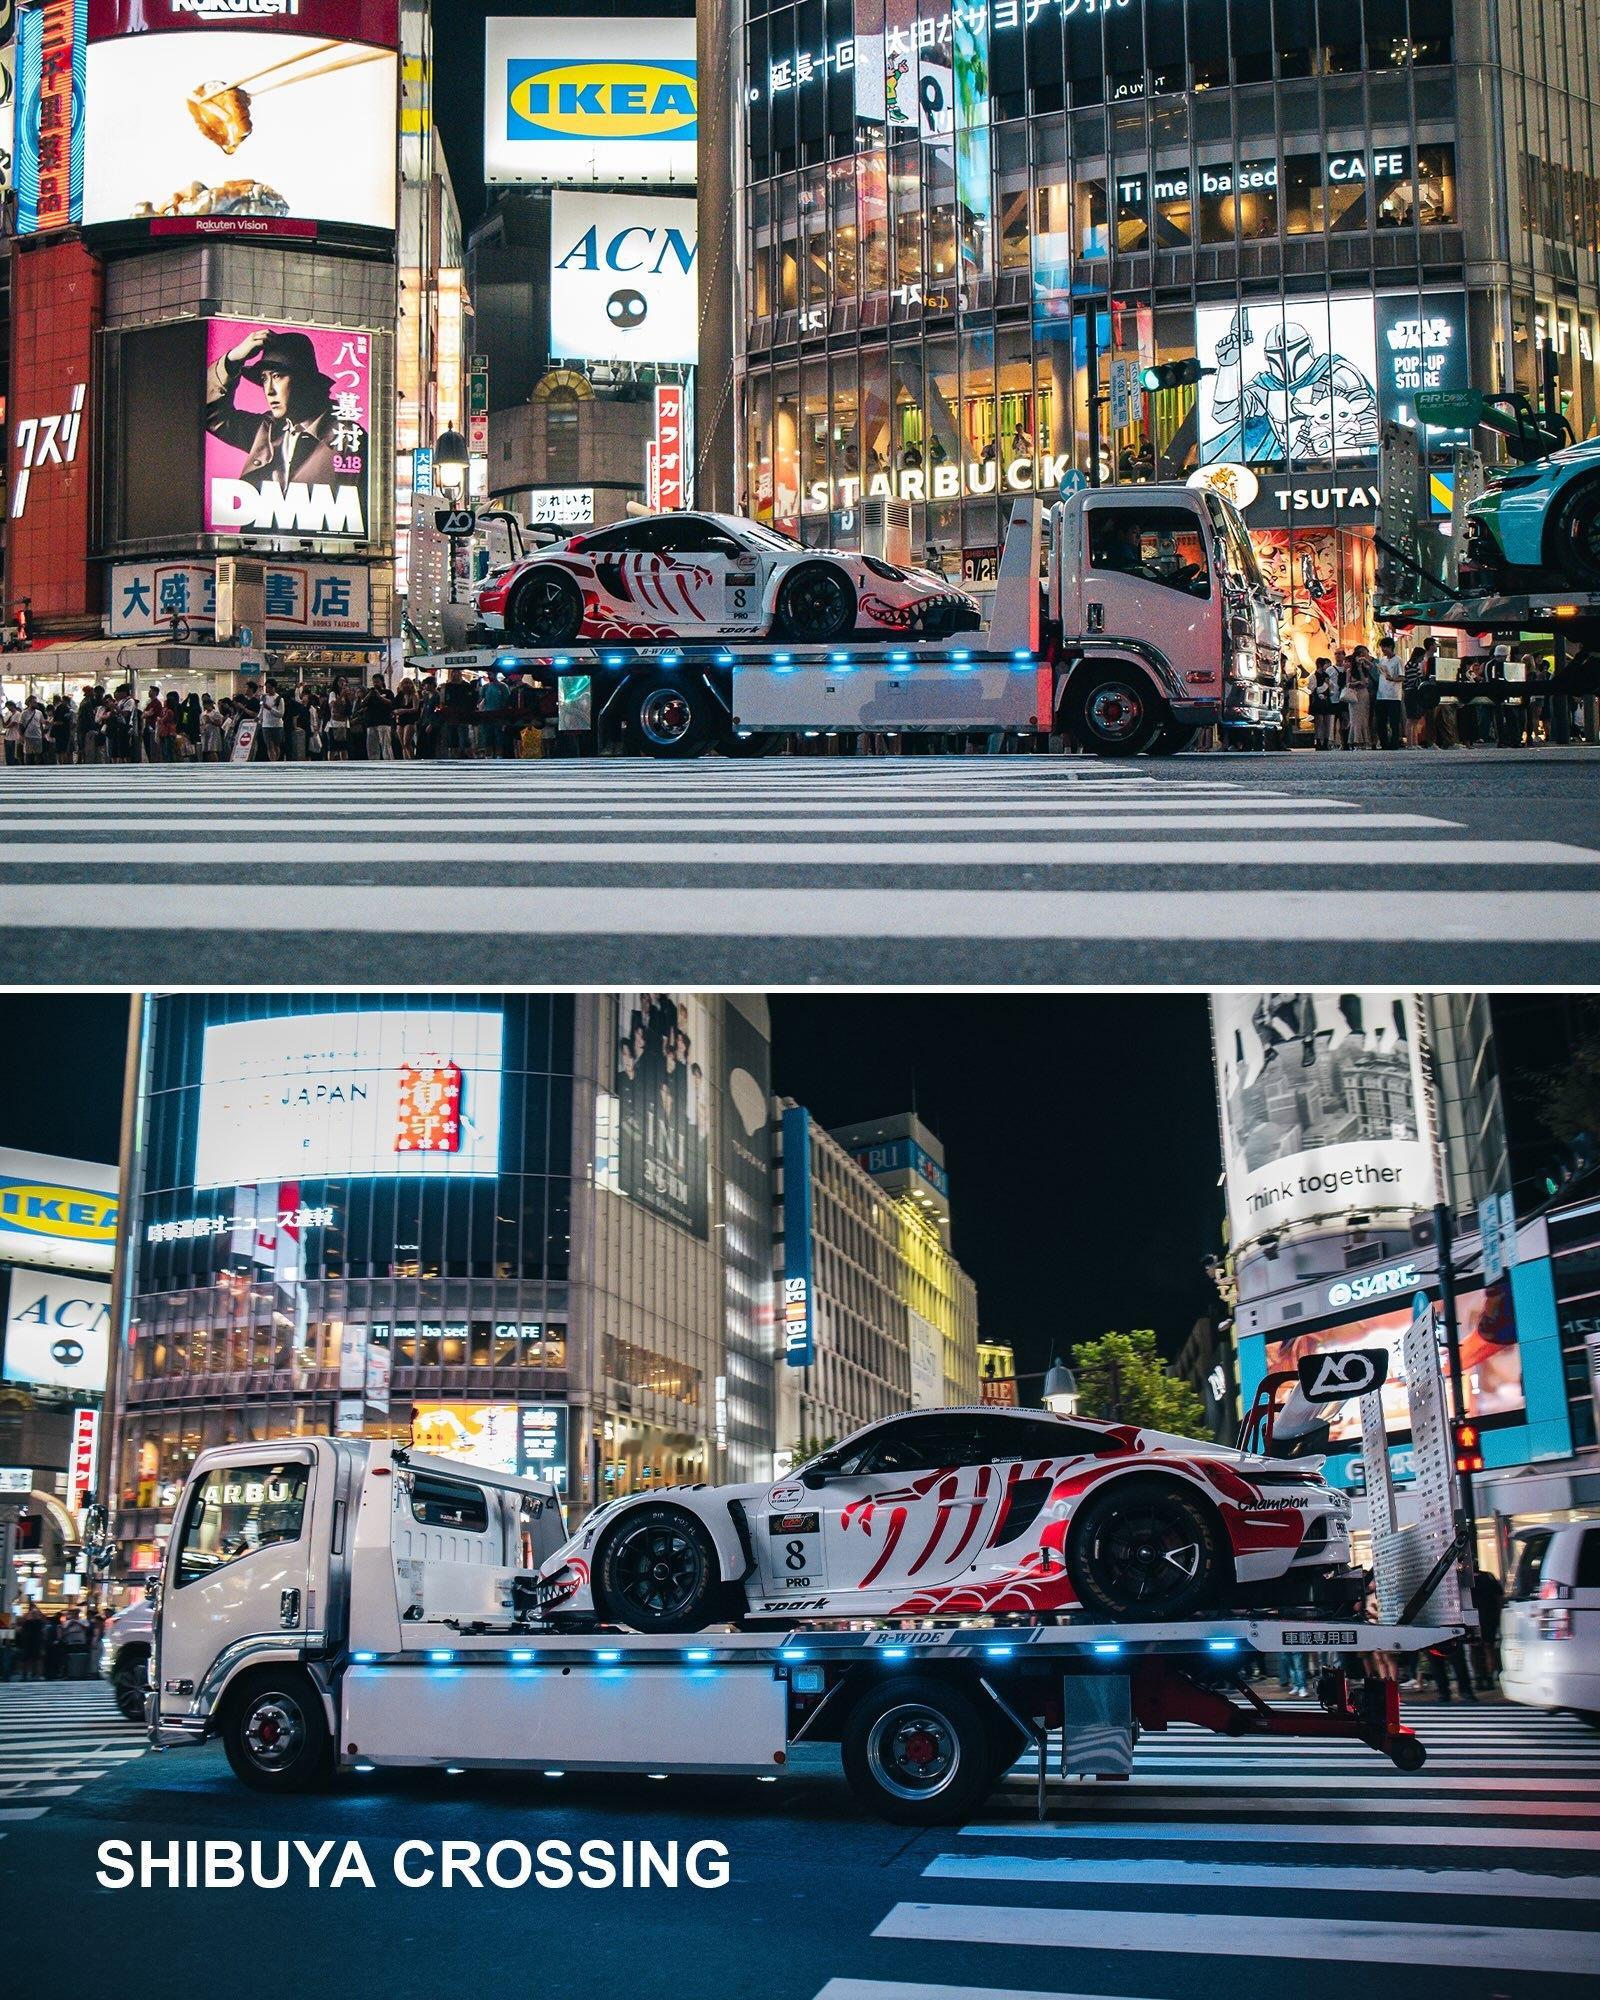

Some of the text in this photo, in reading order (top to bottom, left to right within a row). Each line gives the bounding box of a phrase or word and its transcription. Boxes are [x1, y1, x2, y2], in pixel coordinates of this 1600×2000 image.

[529, 84, 697, 114] IKEA
[1120, 154, 1403, 202] Time based CAFE
[196, 220, 268, 231] Rakuten Vision
[1393, 319, 1451, 339] STAR
[1387, 329, 1450, 350] WARS
[1393, 354, 1446, 374] POP-UP
[1395, 371, 1440, 389] STORE
[330, 341, 366, 453] 八つ墓村
[12, 383, 87, 518] クスリ
[659, 401, 680, 513] カラオケ
[333, 454, 362, 470] 9.18
[811, 451, 1110, 512] STARBUCKS
[211, 476, 366, 533] DMM
[550, 494, 592, 506] れいわ
[536, 509, 592, 522] クリニック
[123, 573, 352, 619] 大盛書店
[733, 589, 747, 608] 8
[717, 626, 761, 634] spark
[1246, 1163, 1403, 1215] Think together
[785, 1278, 807, 1351] SEIBU
[373, 1325, 539, 1338] Time based CAFE
[162, 1482, 288, 1506] SARBU
[1237, 1495, 1309, 1511] Champion
[785, 1540, 806, 1570] 8
[786, 1577, 811, 1588] PRO
[759, 1597, 830, 1612] spark
[874, 1631, 945, 1645] B-WIDE
[1283, 1631, 1355, 1645] 車載専用車
